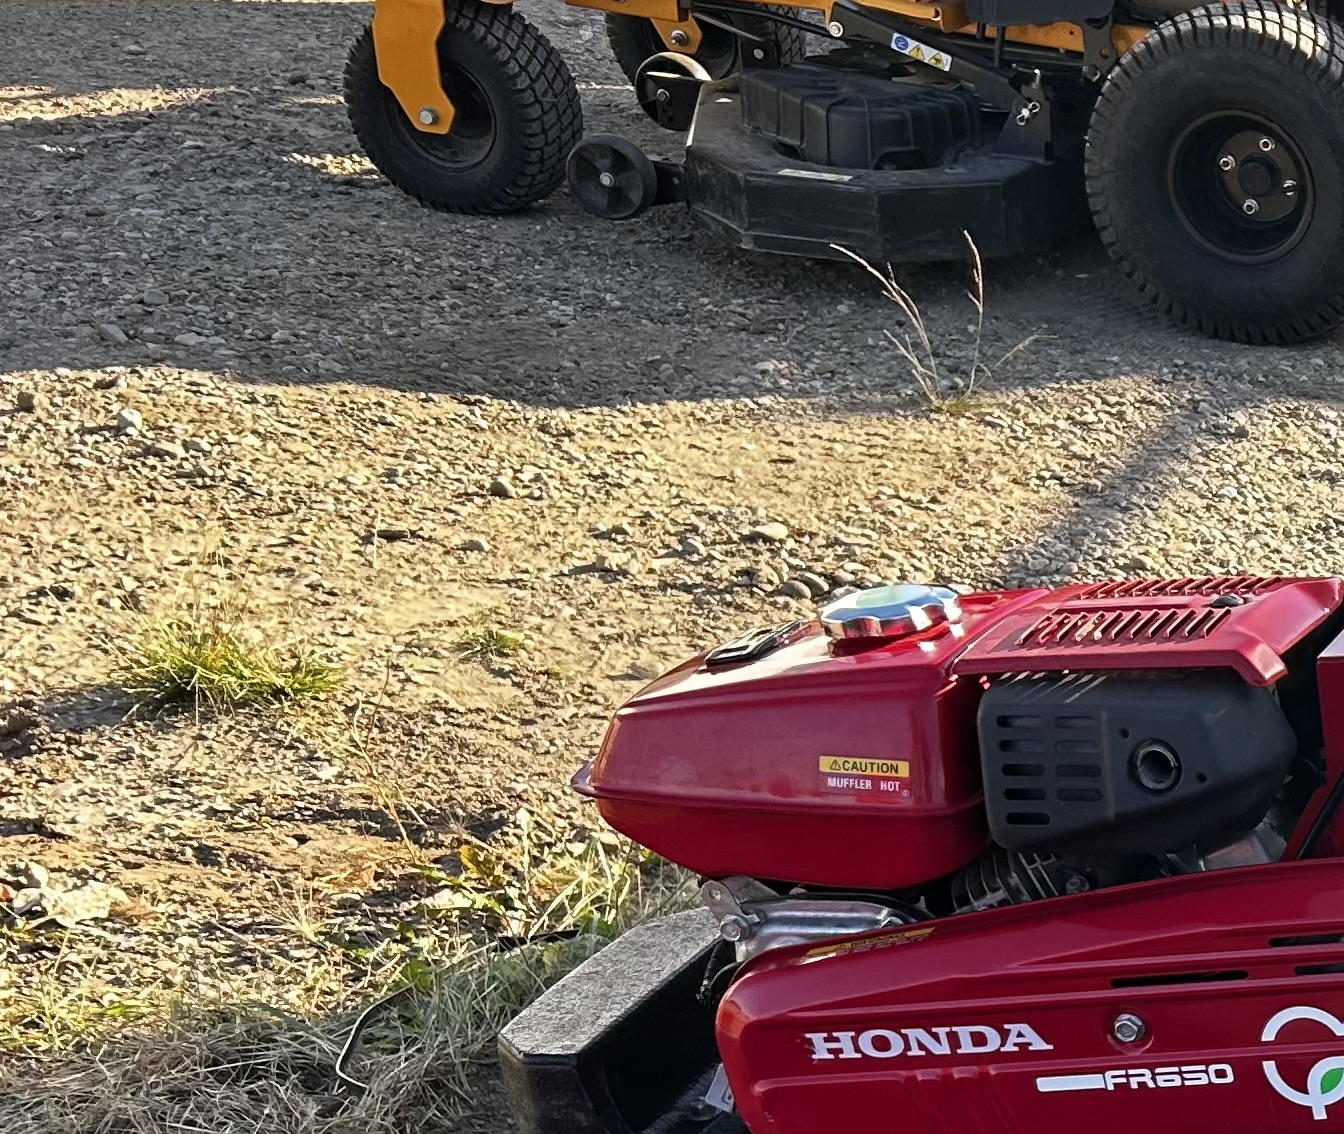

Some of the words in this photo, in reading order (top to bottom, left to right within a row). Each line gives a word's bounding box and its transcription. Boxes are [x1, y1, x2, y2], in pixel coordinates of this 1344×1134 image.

[842, 760, 899, 774] CAUTION
[827, 776, 873, 790] MUFFLER
[880, 780, 901, 792] HOT
[804, 1023, 1054, 1059] HONDA
[1104, 1063, 1235, 1091] FR650
